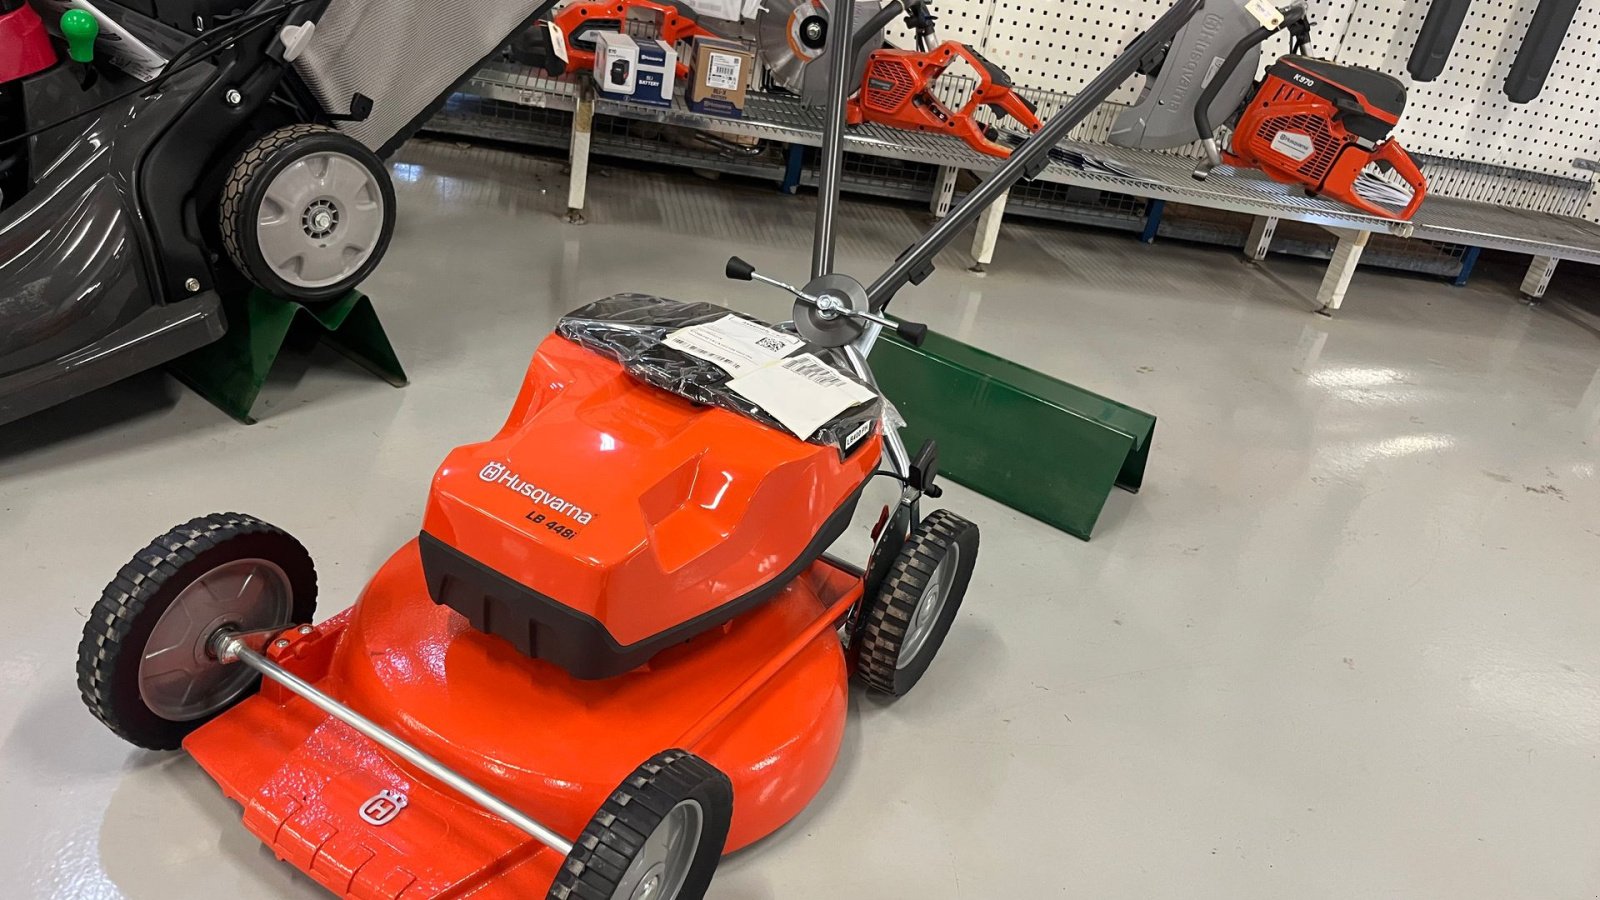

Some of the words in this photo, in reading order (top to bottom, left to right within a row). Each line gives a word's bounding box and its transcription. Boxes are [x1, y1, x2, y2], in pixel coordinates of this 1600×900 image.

[1167, 30, 1215, 113] Husqvarna
[497, 470, 593, 525] Husqvarna
[525, 511, 546, 524] LB
[546, 520, 578, 540] 448i
